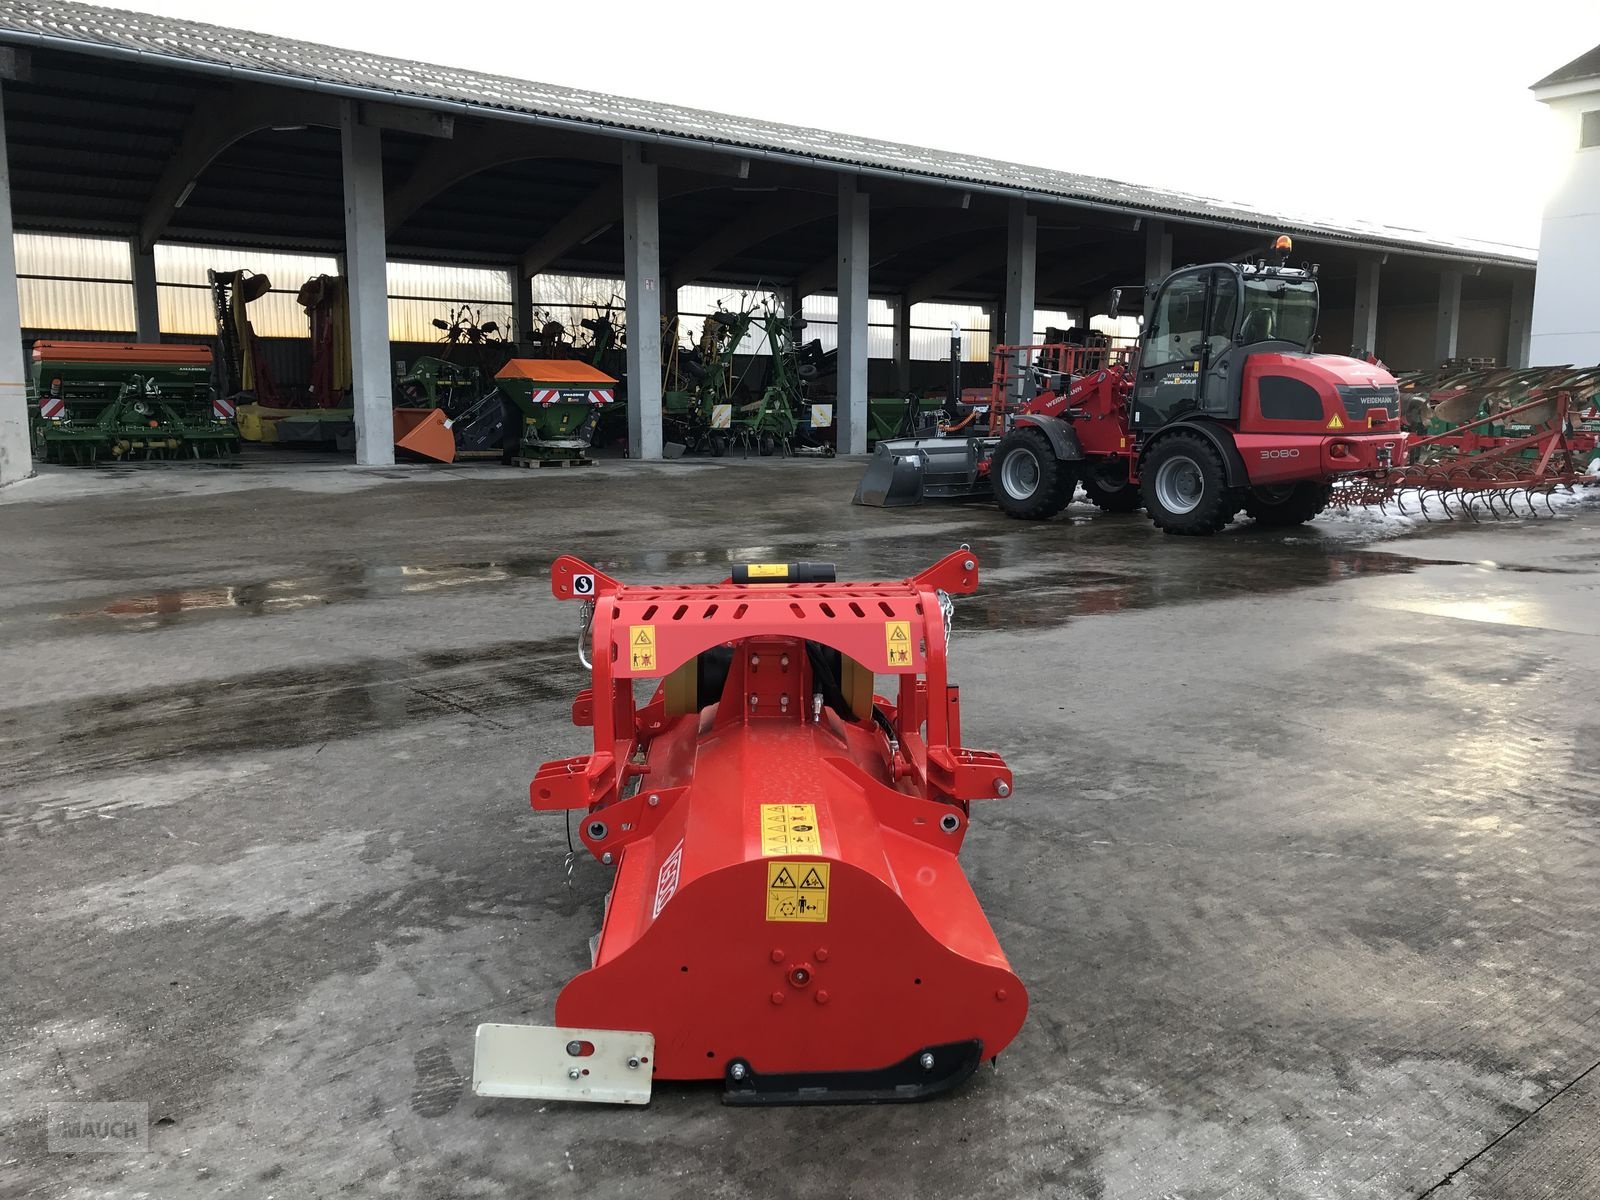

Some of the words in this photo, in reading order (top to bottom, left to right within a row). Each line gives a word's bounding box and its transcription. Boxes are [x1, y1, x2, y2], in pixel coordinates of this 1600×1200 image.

[1045, 385, 1083, 408] WEIDEANN
[1360, 396, 1393, 404] WEIDEMANN
[1260, 449, 1300, 460] 3080
